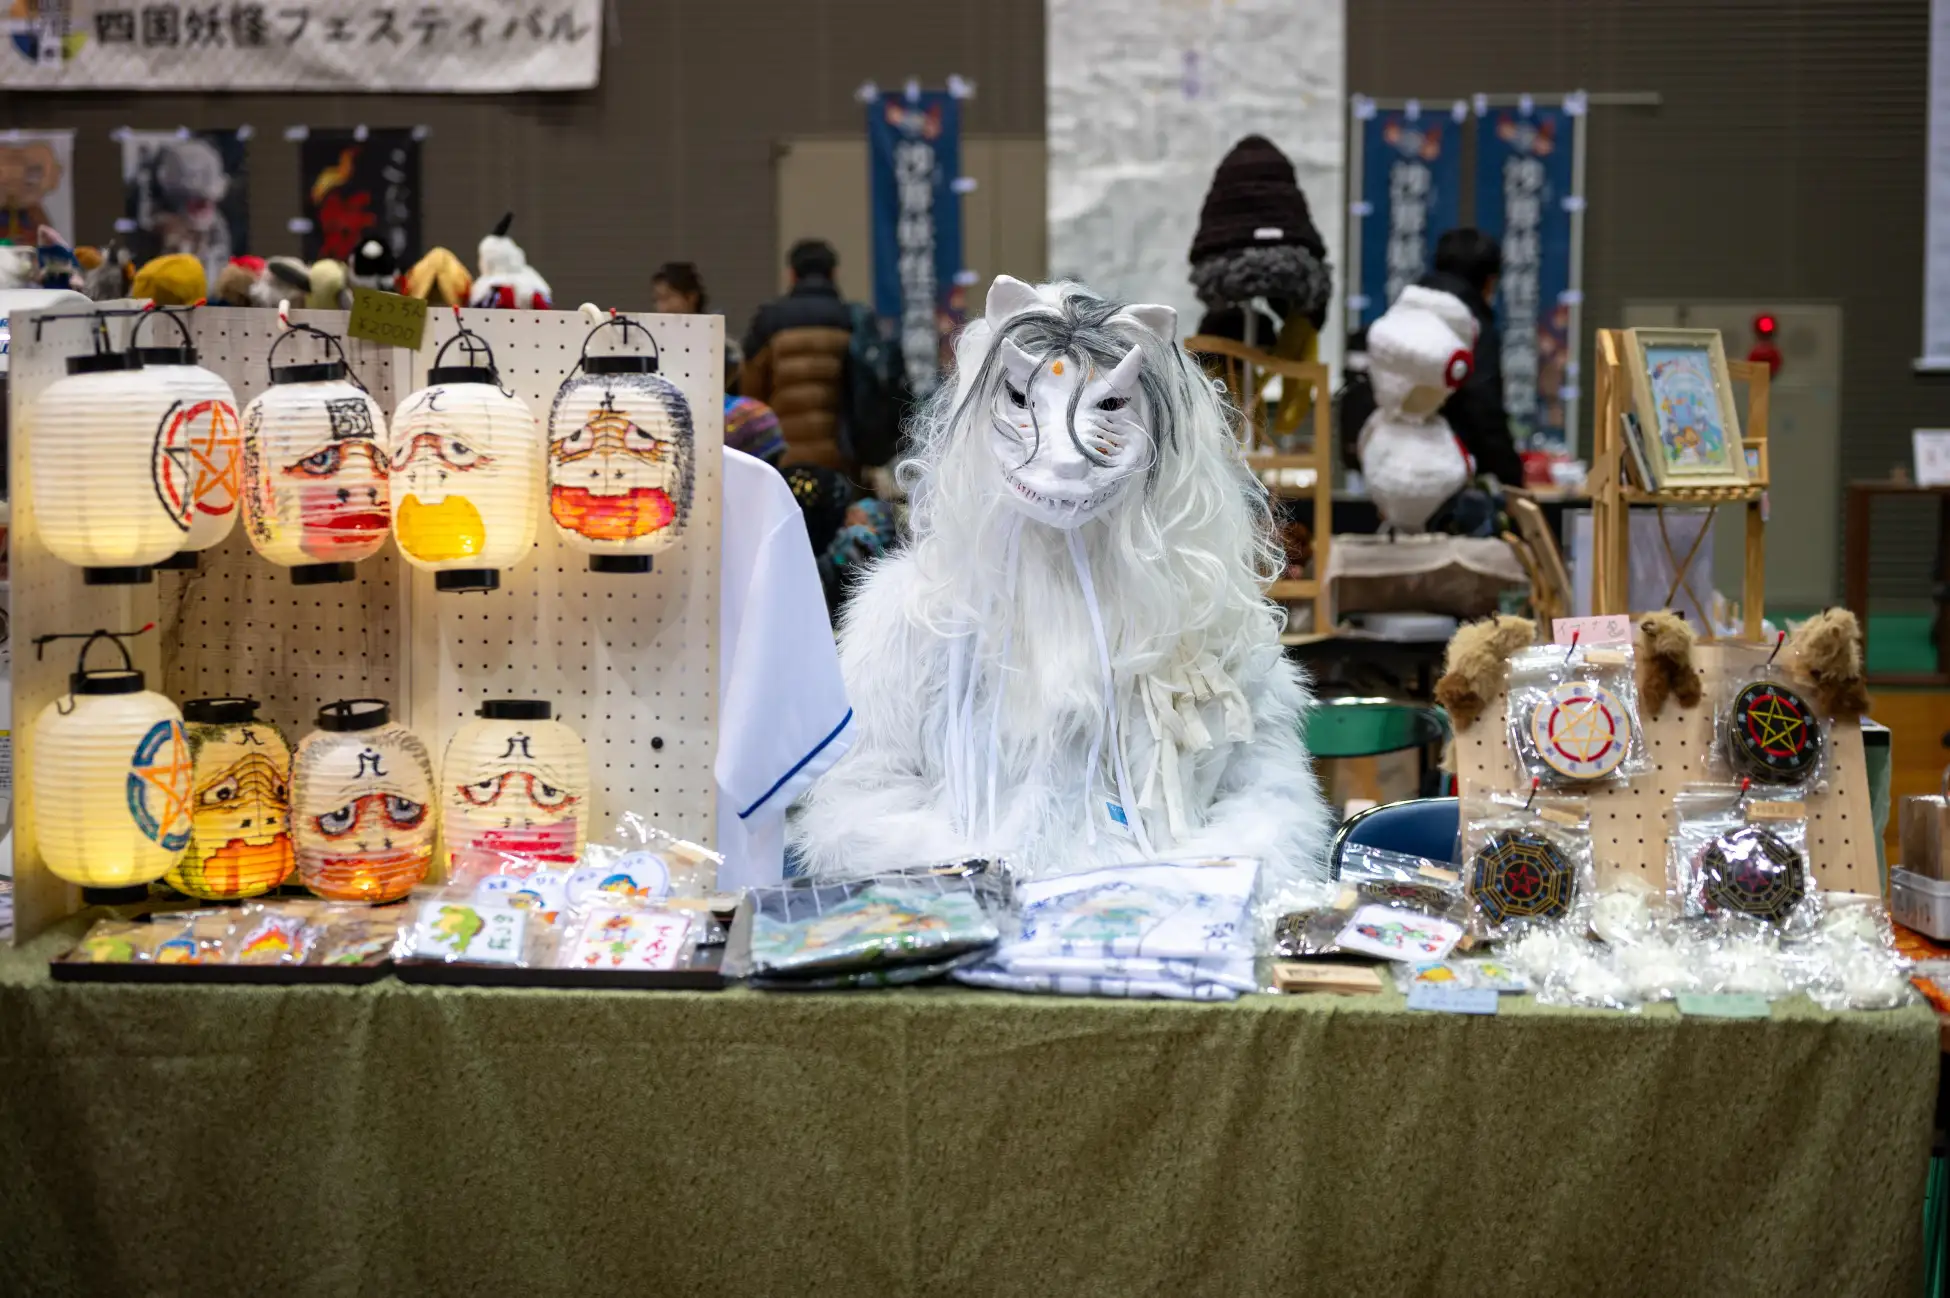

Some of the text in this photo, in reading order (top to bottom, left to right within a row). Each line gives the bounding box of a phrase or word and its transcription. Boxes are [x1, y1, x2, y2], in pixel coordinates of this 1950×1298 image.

[95, 4, 591, 48] 四国妖怪フェスティバル
[362, 296, 425, 318] ちょうちん
[359, 317, 415, 340] ¥2000
